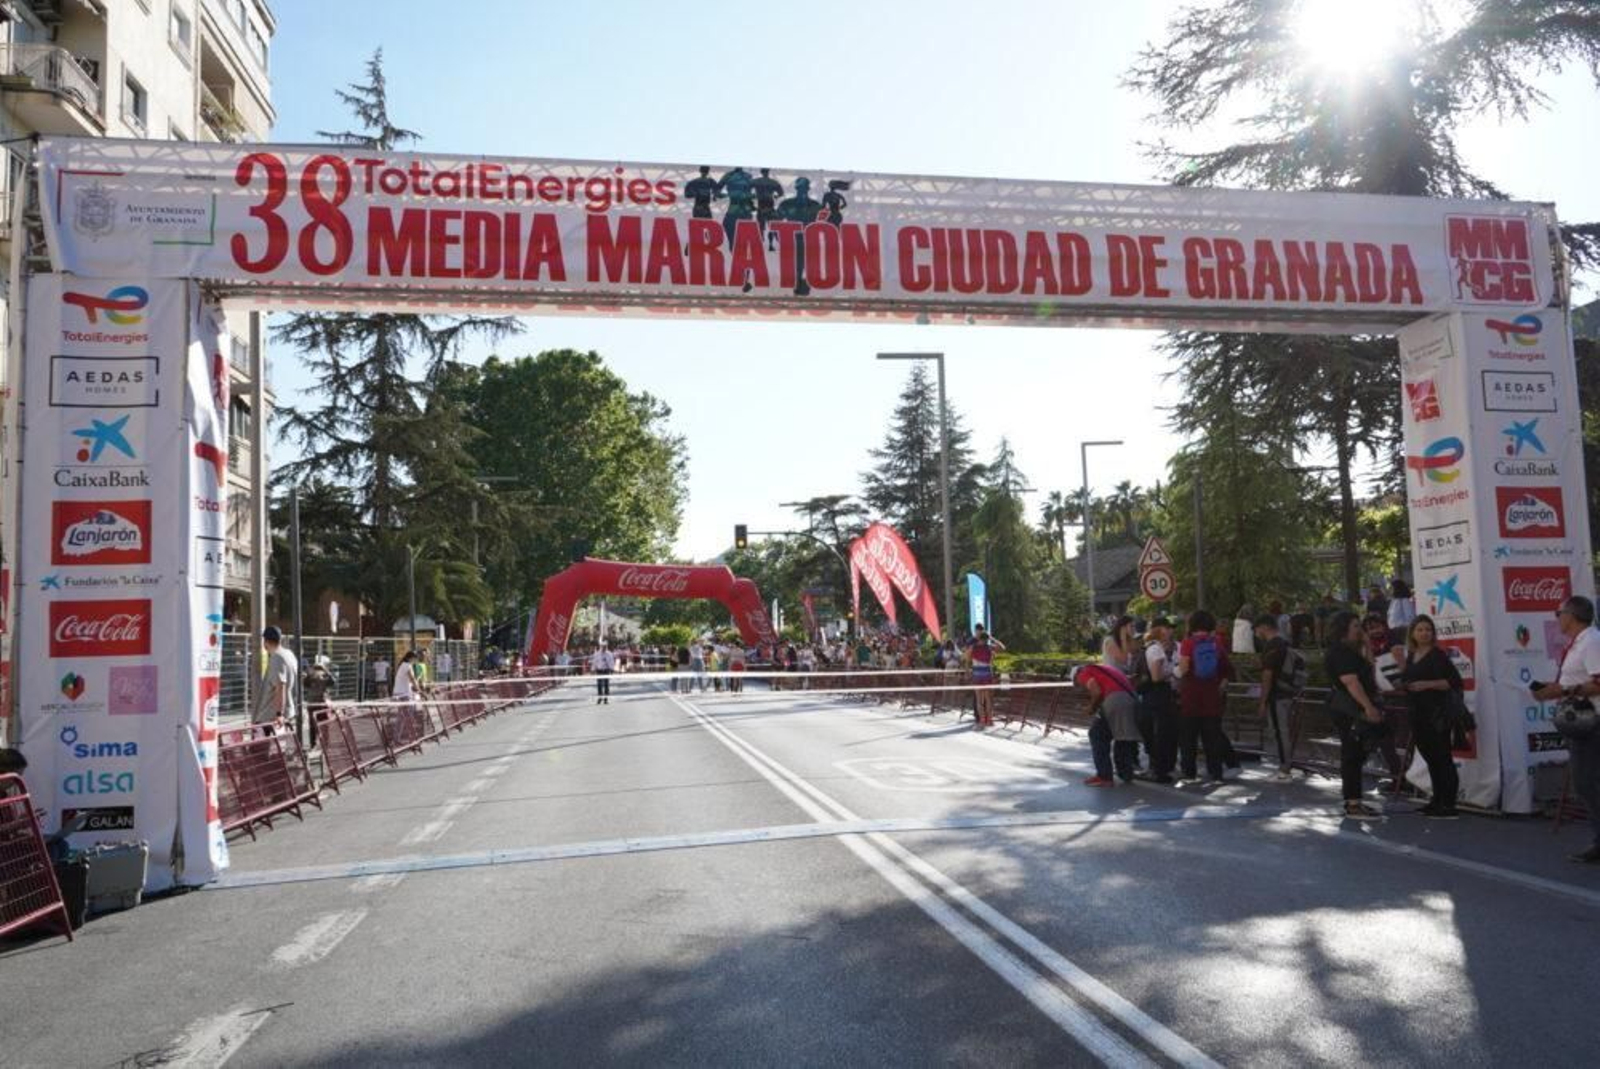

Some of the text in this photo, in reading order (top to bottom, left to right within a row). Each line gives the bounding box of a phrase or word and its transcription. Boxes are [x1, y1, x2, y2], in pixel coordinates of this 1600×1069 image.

[355, 158, 677, 212] TotalEnergies
[230, 152, 354, 275] 38
[366, 206, 1424, 305] MEDIA MARATÓN CIUDAD DE GRANADA
[62, 330, 149, 345] TotalEnergies
[66, 371, 144, 383] AEDAS
[1495, 382, 1546, 393] AEDAS
[1494, 461, 1559, 476] CaixaBank
[54, 469, 151, 487] CaixaBank
[1508, 508, 1555, 524] Lanjarón
[67, 526, 137, 546] Lanjarón
[1150, 578, 1168, 590] 30
[75, 740, 139, 758] sima
[63, 769, 135, 795] alsa
